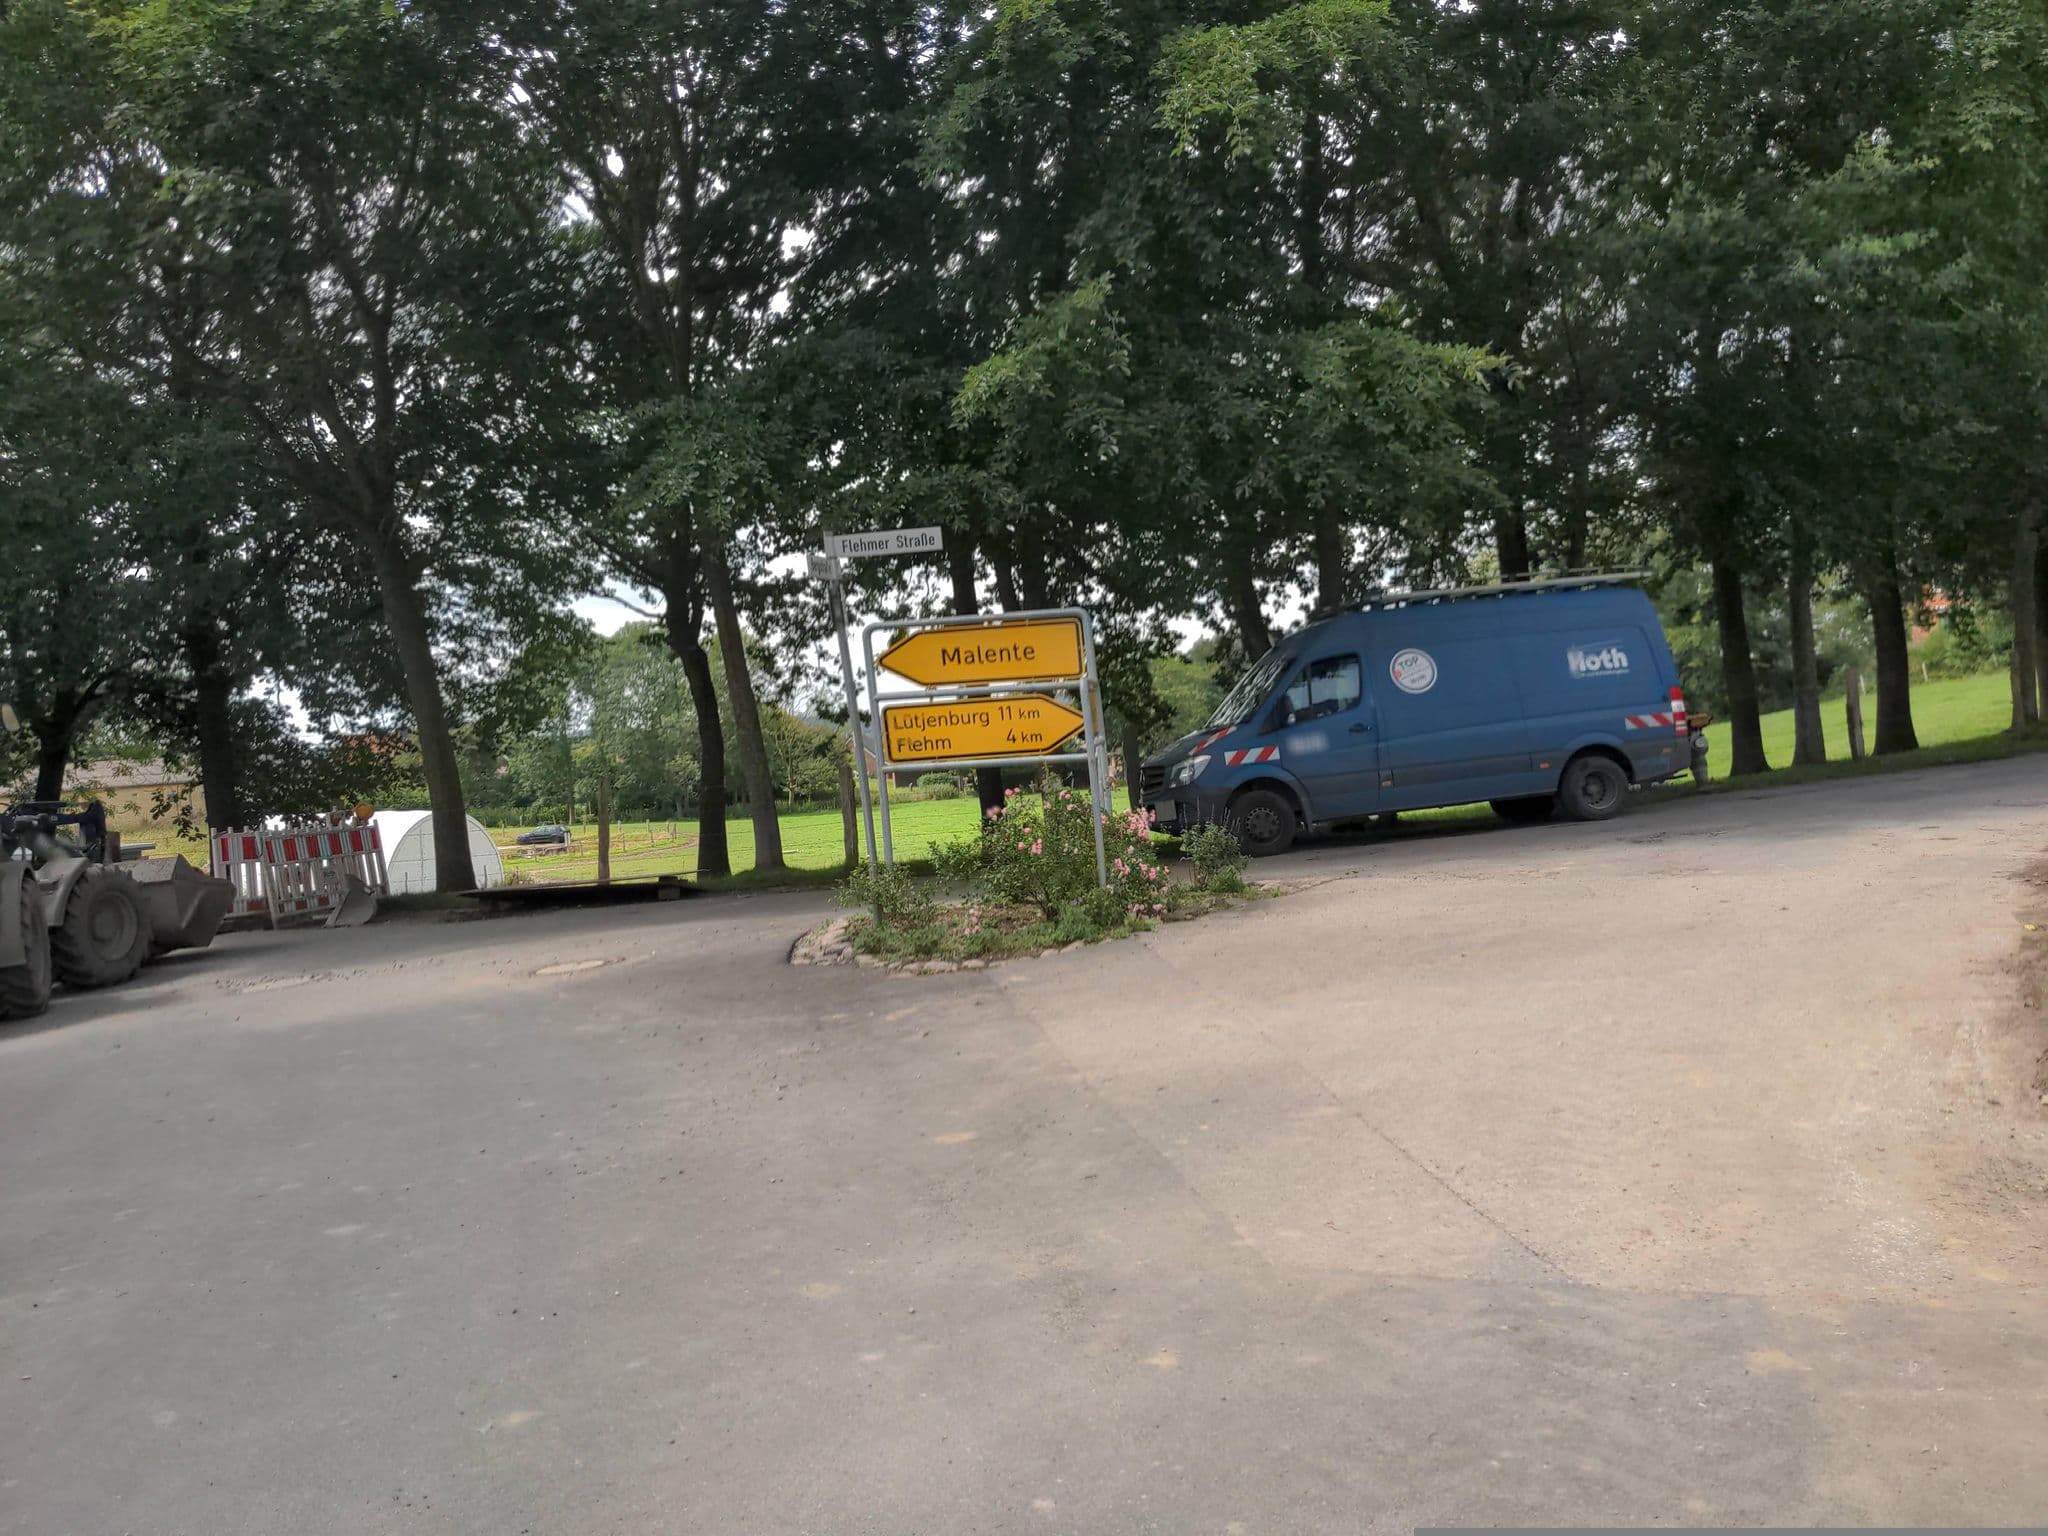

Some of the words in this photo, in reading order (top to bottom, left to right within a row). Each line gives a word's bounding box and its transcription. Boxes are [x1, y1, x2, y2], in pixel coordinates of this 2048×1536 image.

[841, 537, 890, 553] Flehmer
[896, 532, 935, 549] Straße
[940, 643, 1036, 667] Malente
[893, 710, 990, 732] Lütjenburg
[998, 706, 1013, 721] 11
[1018, 707, 1041, 720] km
[896, 735, 952, 753] Flehm
[1006, 727, 1017, 744] 4
[1021, 731, 1043, 744] km
